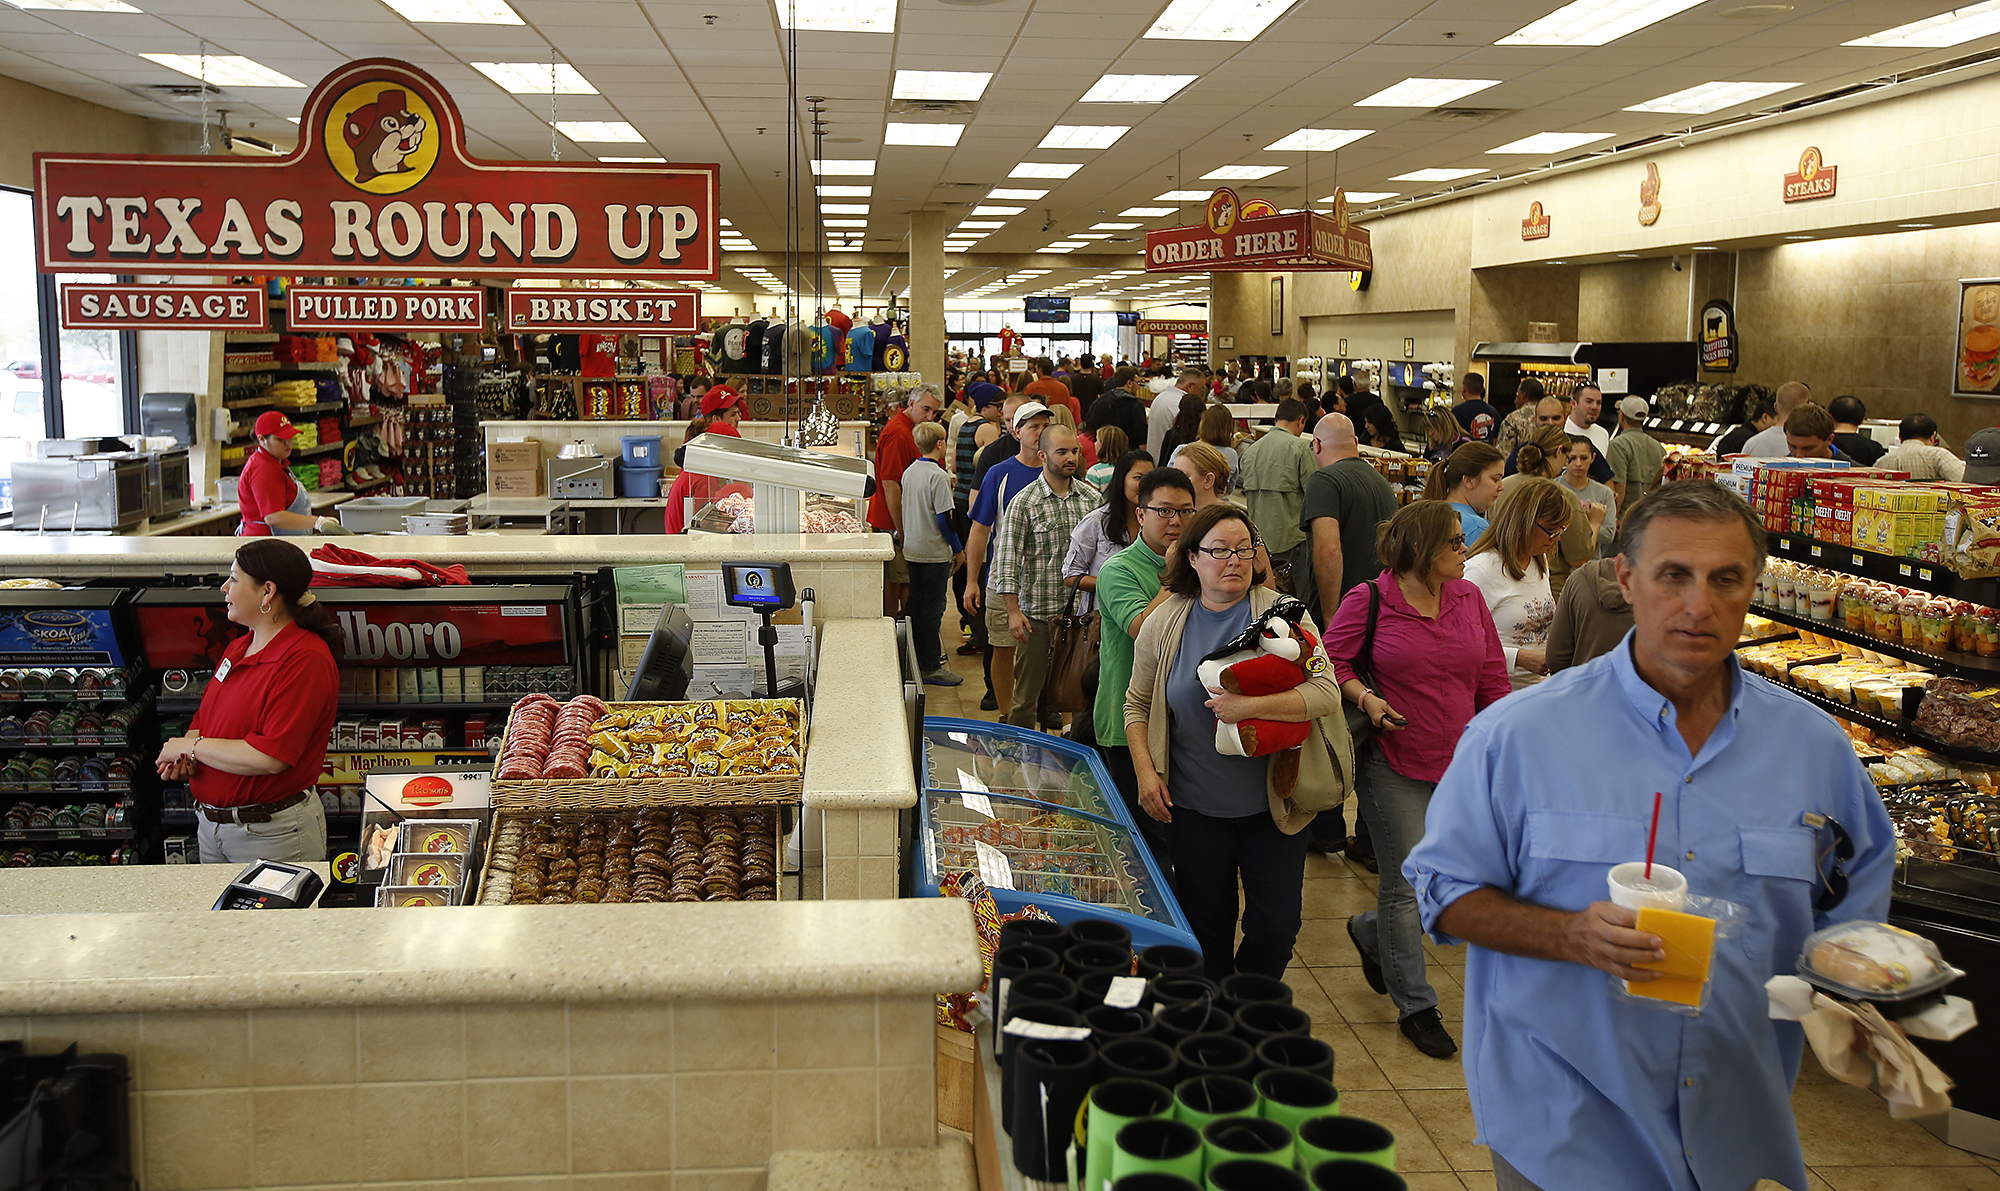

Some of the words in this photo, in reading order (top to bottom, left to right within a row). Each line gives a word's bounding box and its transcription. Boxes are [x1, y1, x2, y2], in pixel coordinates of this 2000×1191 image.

[1786, 178, 1831, 198] STEAKS
[56, 195, 304, 257] TEXAS
[329, 199, 578, 259] ROUND
[603, 204, 699, 260] UP
[1522, 224, 1548, 237] SAUSAGE
[1152, 238, 1225, 265] ORDER
[1234, 228, 1299, 257] HERE
[1314, 229, 1346, 257] ORDER
[1347, 238, 1370, 264] HERE
[80, 294, 250, 319] SAUSAGE
[298, 295, 398, 321] PULLED
[405, 297, 476, 321] PORK
[529, 298, 677, 323] BRISKET
[1149, 322, 1206, 332] OUTDOORS
[1703, 338, 1729, 352] CERTIFIED
[1717, 348, 1730, 359] BEEF
[1735, 463, 1754, 472] PREMIUM
[33, 627, 75, 639] SKOAL
[336, 610, 462, 660] lboro
[350, 755, 411, 770] Marlboro
